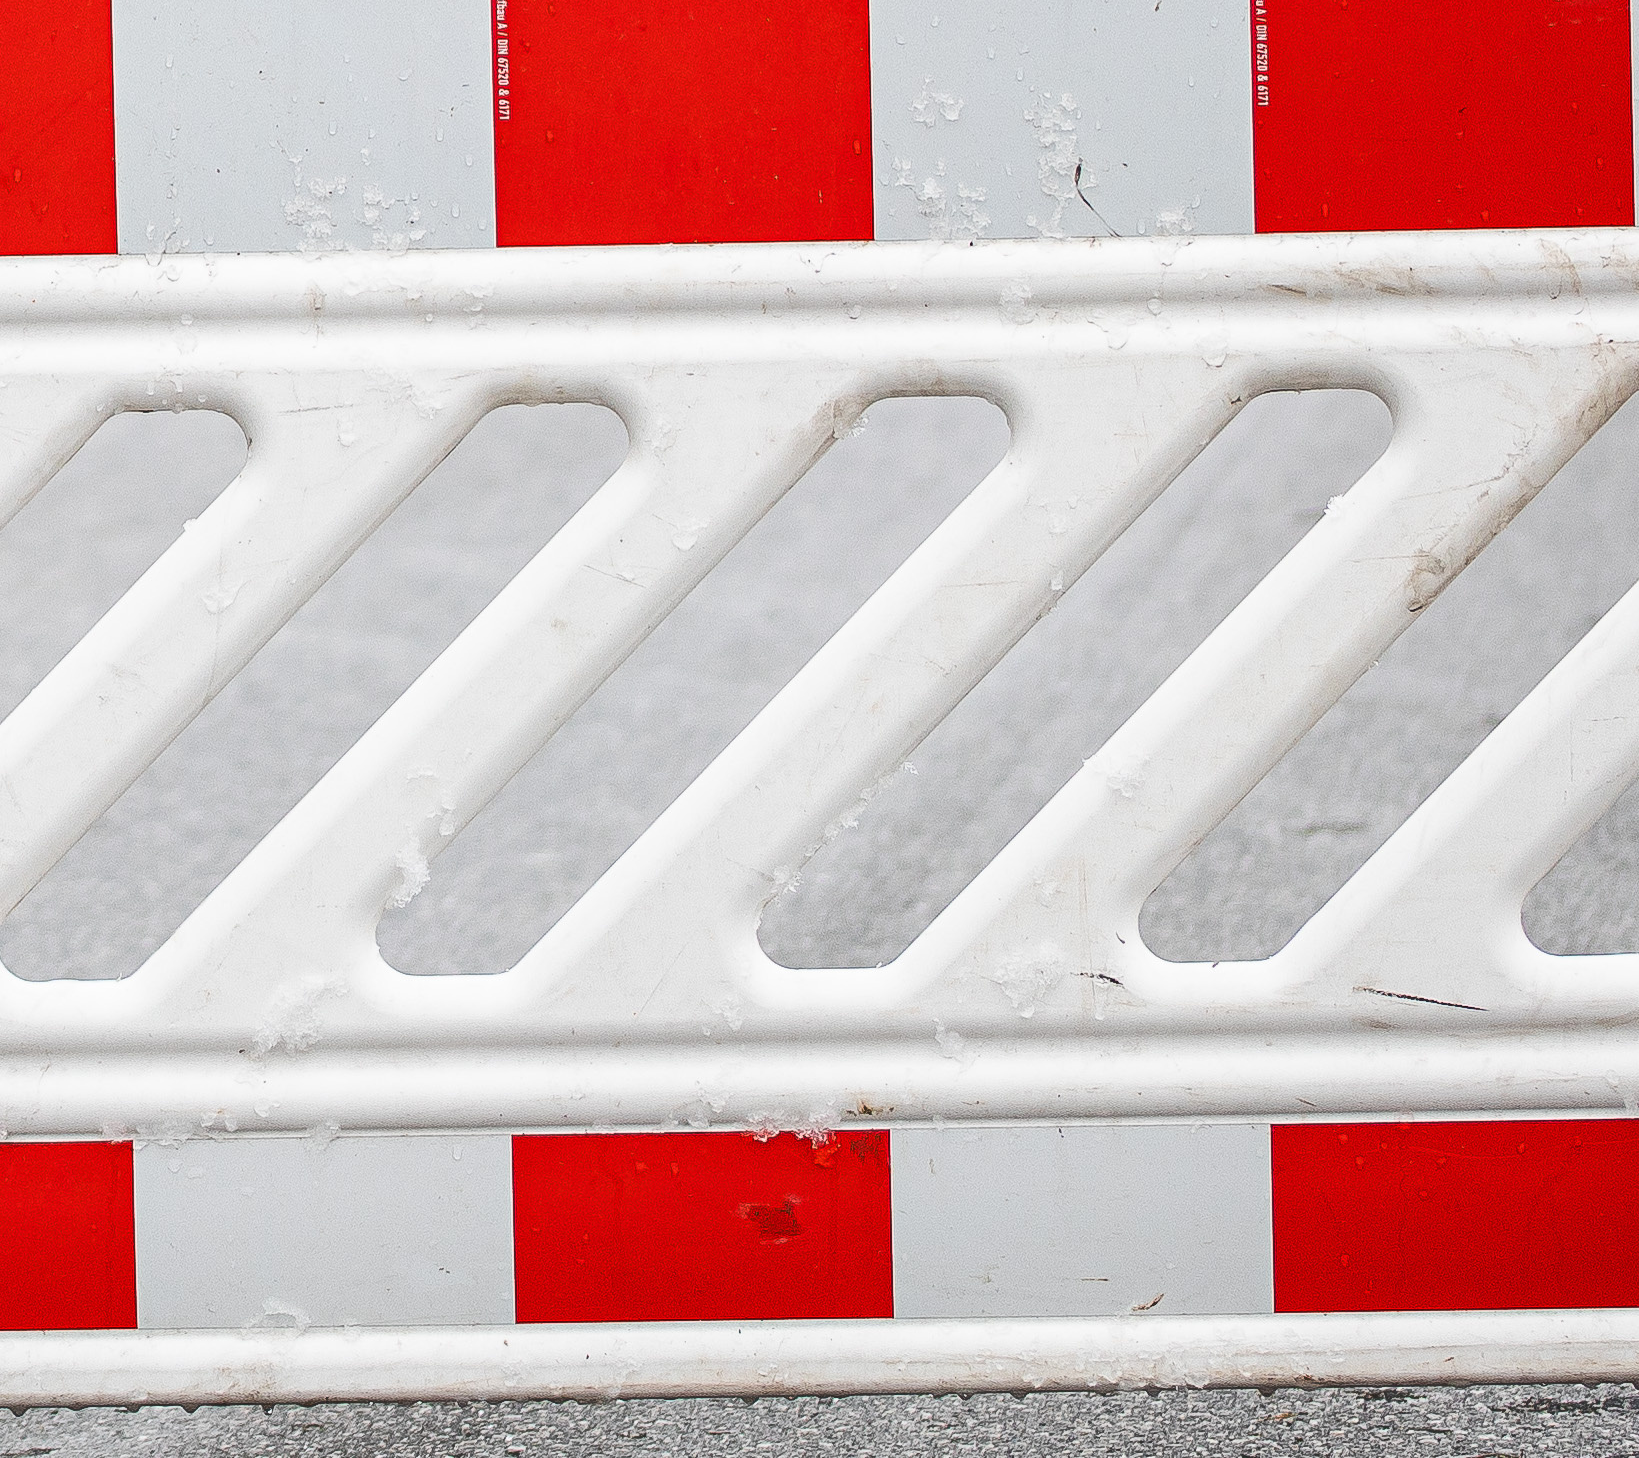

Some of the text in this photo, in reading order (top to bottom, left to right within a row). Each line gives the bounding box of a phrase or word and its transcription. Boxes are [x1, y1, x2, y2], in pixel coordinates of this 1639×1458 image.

[1255, 7, 1267, 16] A
[496, 21, 508, 30] A
[1255, 24, 1268, 41] DIN
[497, 38, 509, 55] DIN
[1256, 42, 1268, 72] 67520
[497, 57, 510, 86] 67520
[1256, 74, 1269, 82] &
[498, 88, 510, 97] &
[1257, 84, 1269, 106] 6171
[498, 99, 510, 120] 6171
